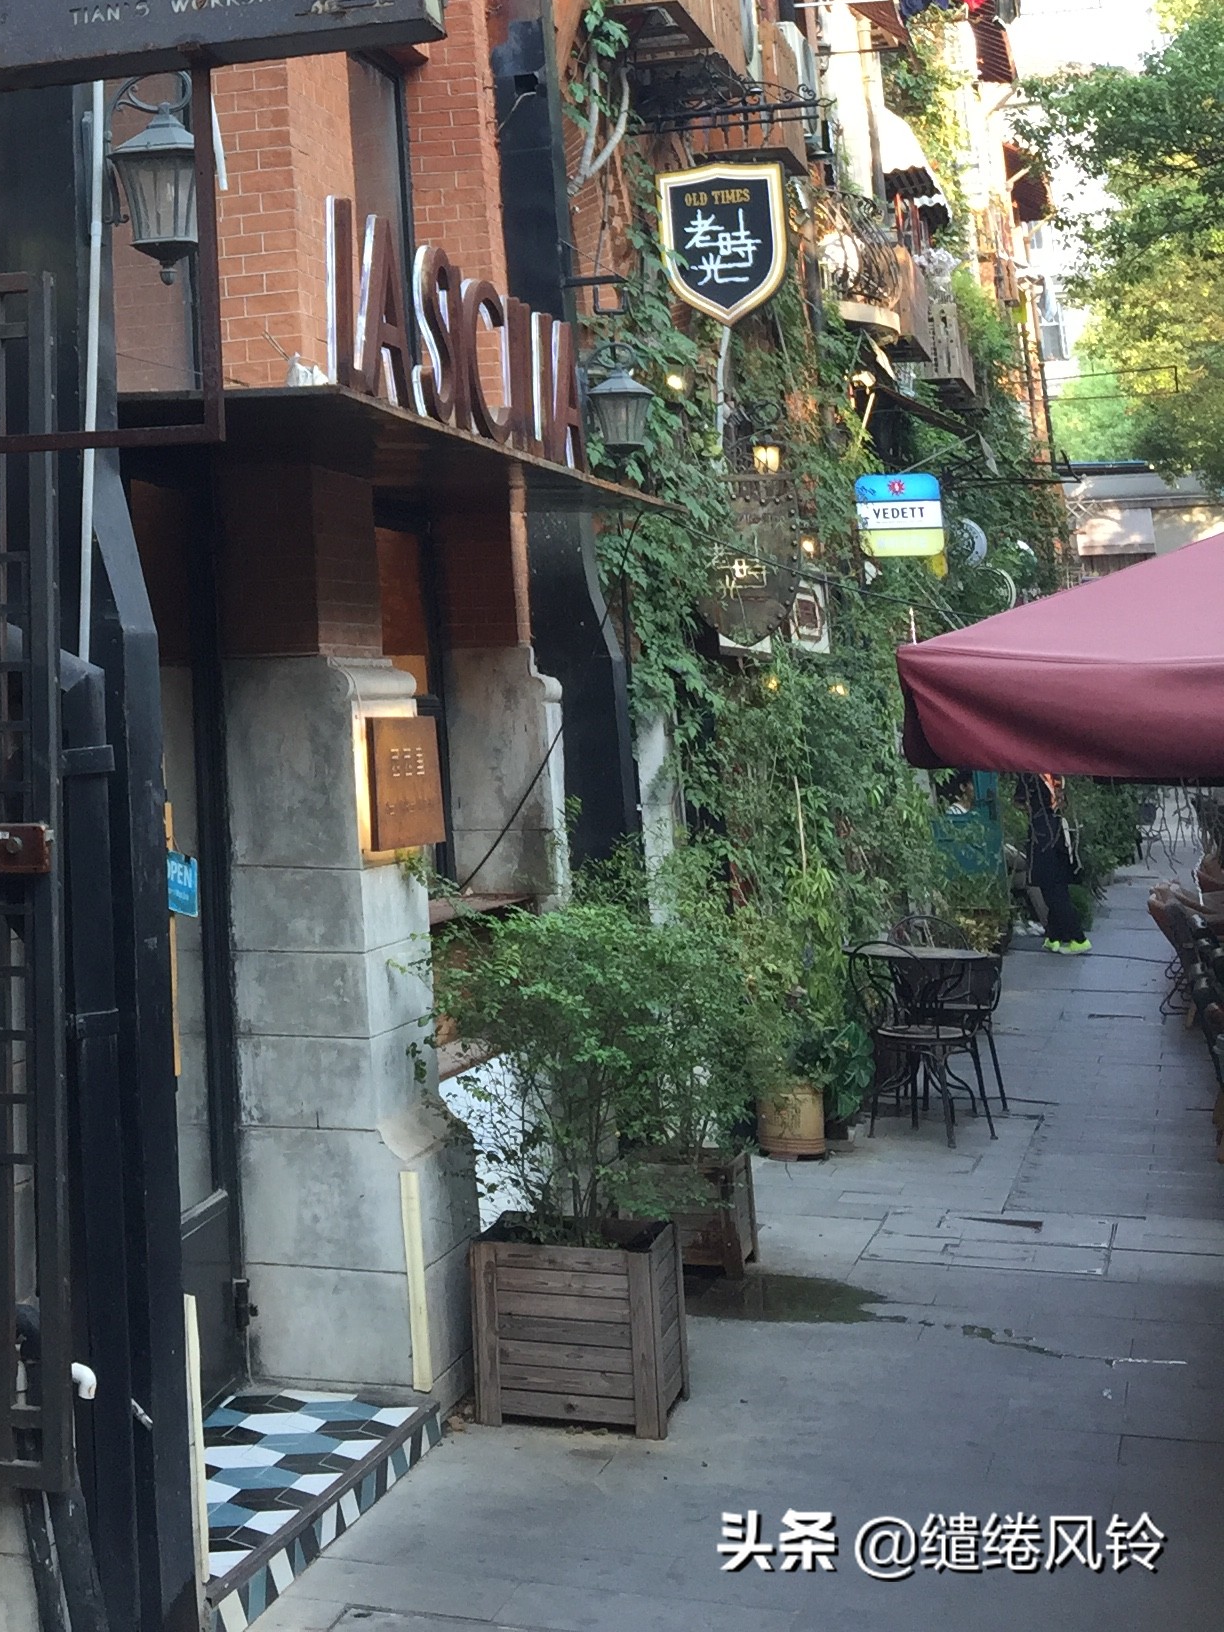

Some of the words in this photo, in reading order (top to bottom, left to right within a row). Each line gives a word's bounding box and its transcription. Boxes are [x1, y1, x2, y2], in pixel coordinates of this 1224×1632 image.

[684, 191, 708, 207] OLD
[711, 188, 751, 205] TIMES
[872, 506, 926, 520] VEDETT
